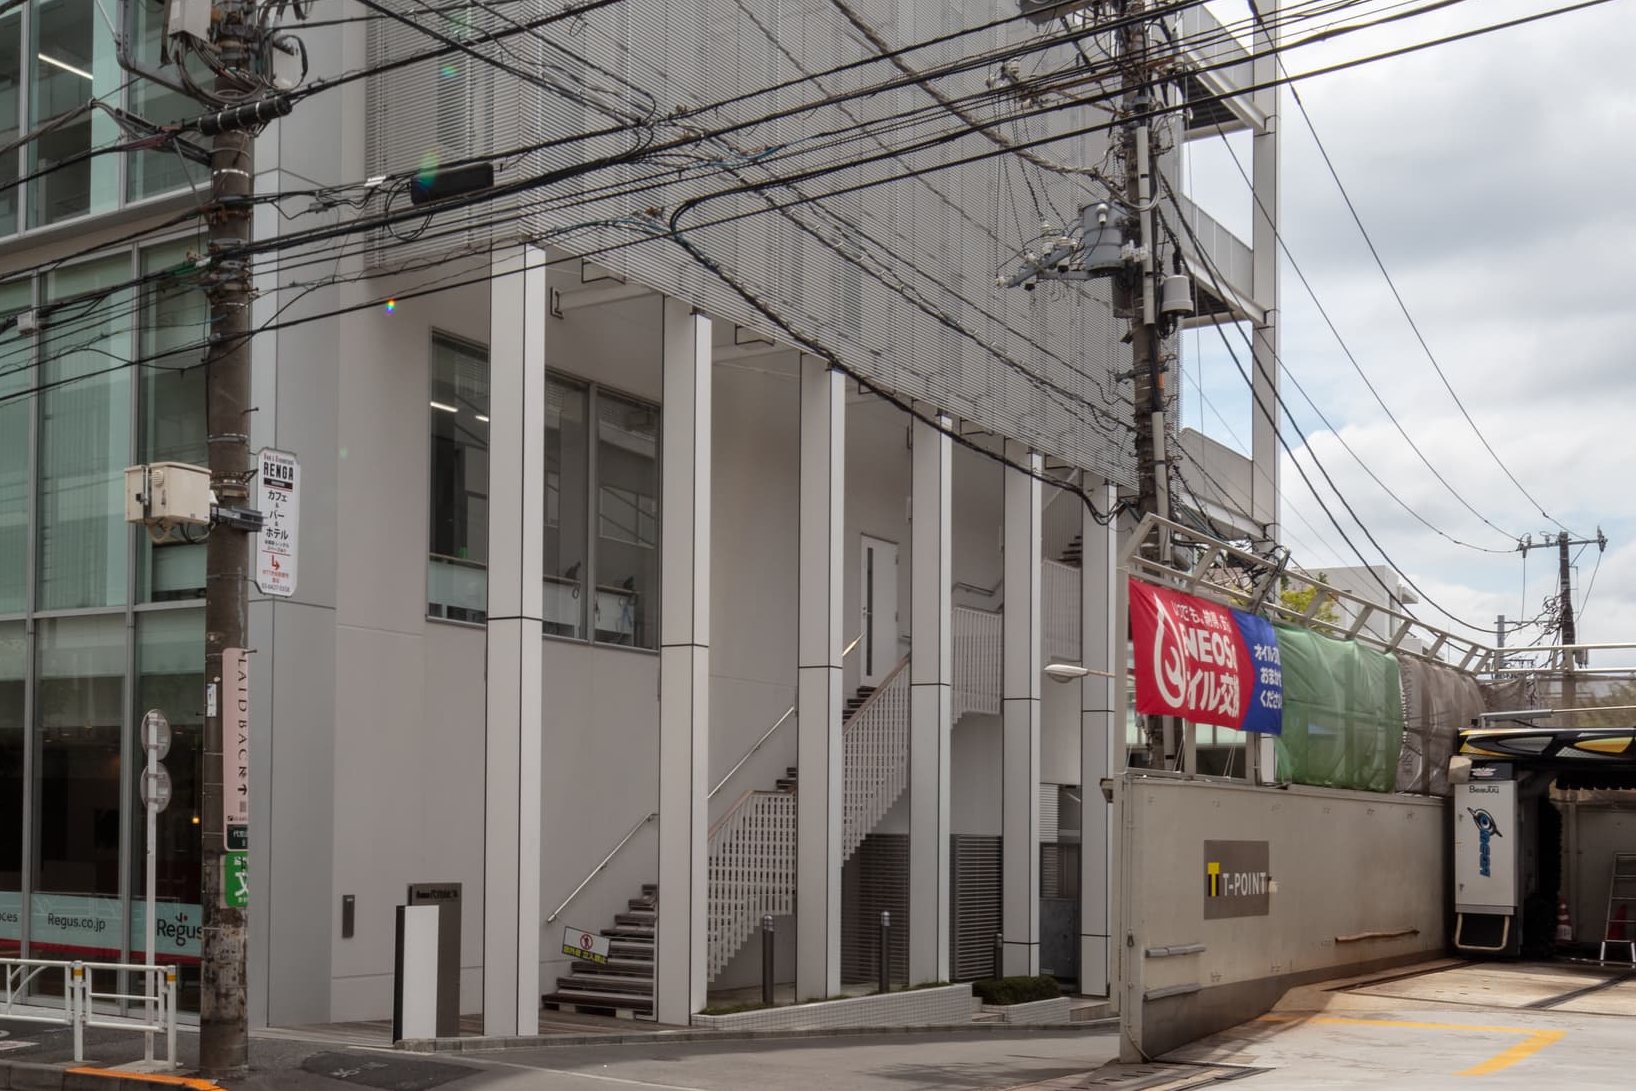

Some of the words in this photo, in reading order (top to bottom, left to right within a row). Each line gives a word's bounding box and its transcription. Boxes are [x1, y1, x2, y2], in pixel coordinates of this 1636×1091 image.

[264, 462, 294, 481] RENGA
[268, 490, 288, 503] カフェ
[269, 510, 285, 520] バー
[266, 527, 289, 541] ホテル
[238, 658, 247, 712] LAID
[238, 720, 247, 777] BACK
[1222, 872, 1267, 897] T-POINT
[47, 913, 106, 932] Regus.co.jp
[156, 918, 203, 947] Regus
